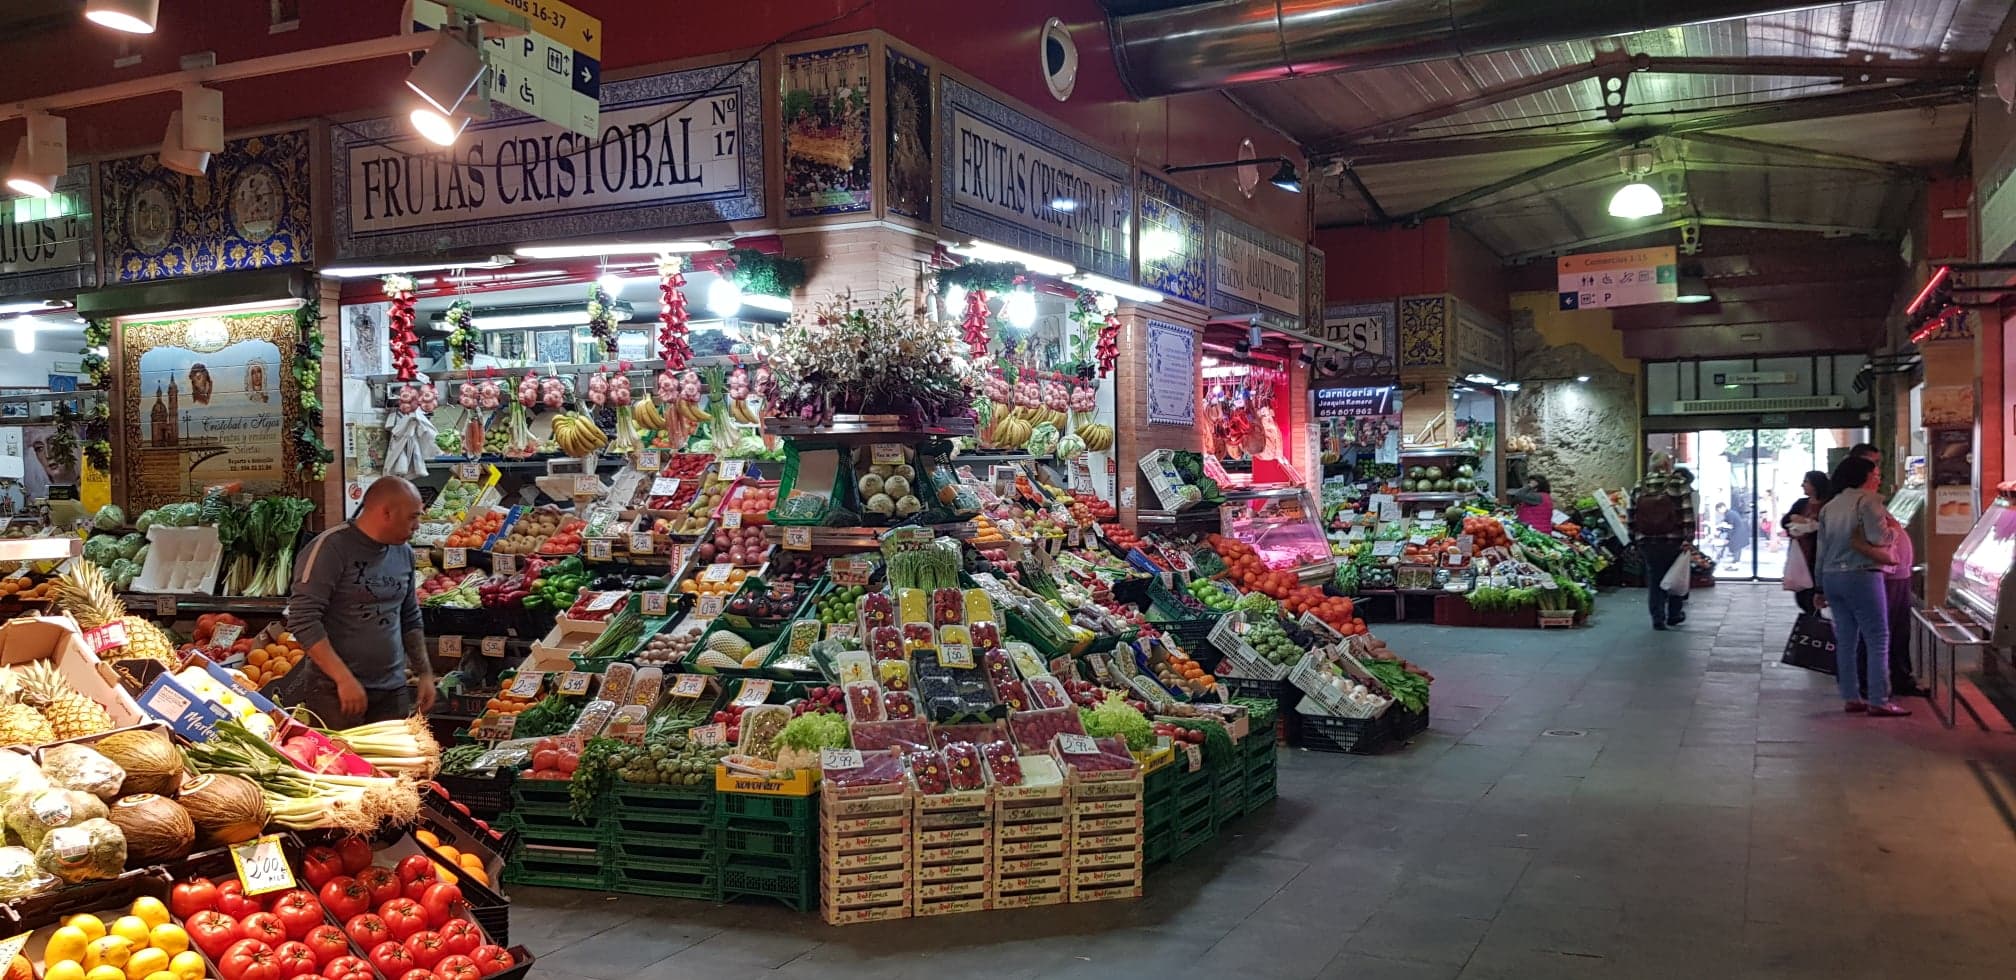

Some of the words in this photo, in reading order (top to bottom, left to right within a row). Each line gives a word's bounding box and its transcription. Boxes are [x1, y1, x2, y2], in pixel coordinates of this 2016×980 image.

[533, 2, 566, 29] 16-37
[714, 130, 736, 157] 17
[362, 140, 485, 220] FRUTAS
[496, 117, 703, 205] CRISTOBAL
[961, 127, 1026, 215] FRUTAS
[1376, 387, 1389, 414] 7
